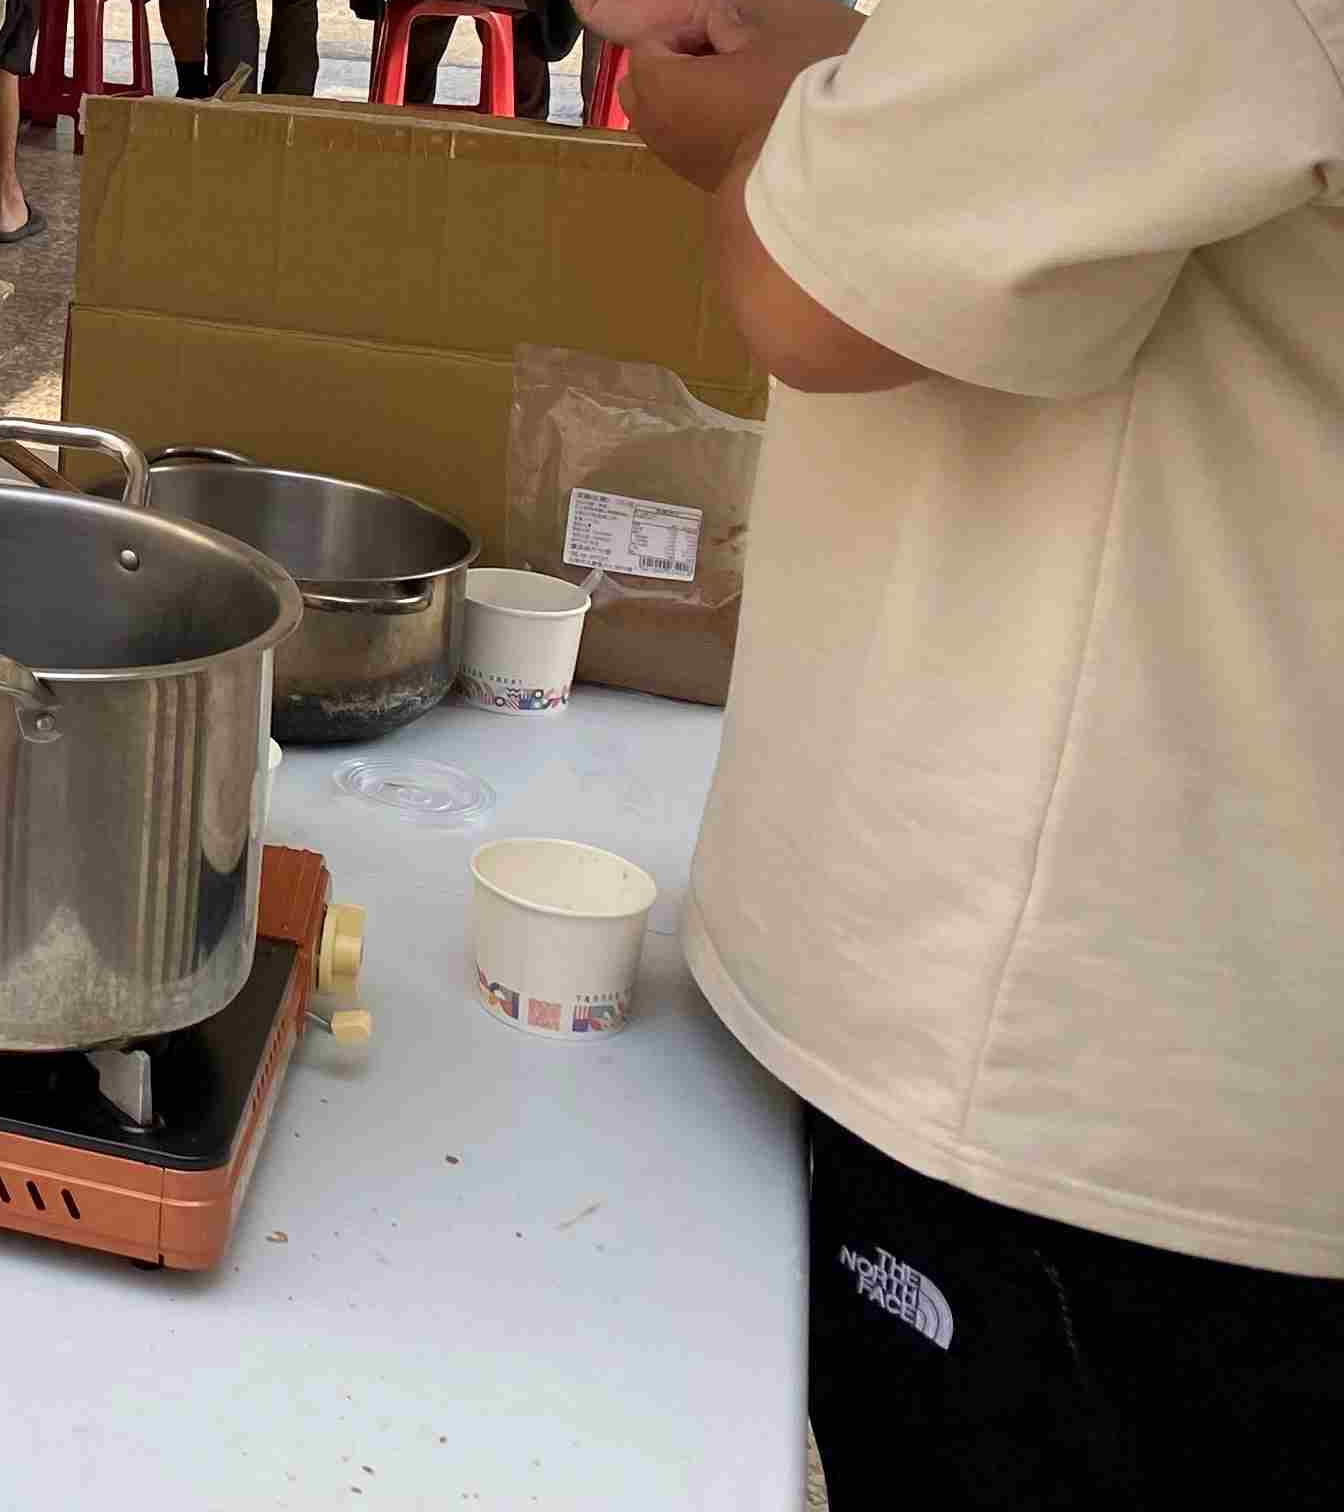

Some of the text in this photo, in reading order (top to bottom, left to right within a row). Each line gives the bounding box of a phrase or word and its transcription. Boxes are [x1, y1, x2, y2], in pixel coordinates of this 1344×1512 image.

[839, 1244, 920, 1310] NORTH
[874, 1246, 921, 1290] THE
[857, 1271, 916, 1324] FACE
